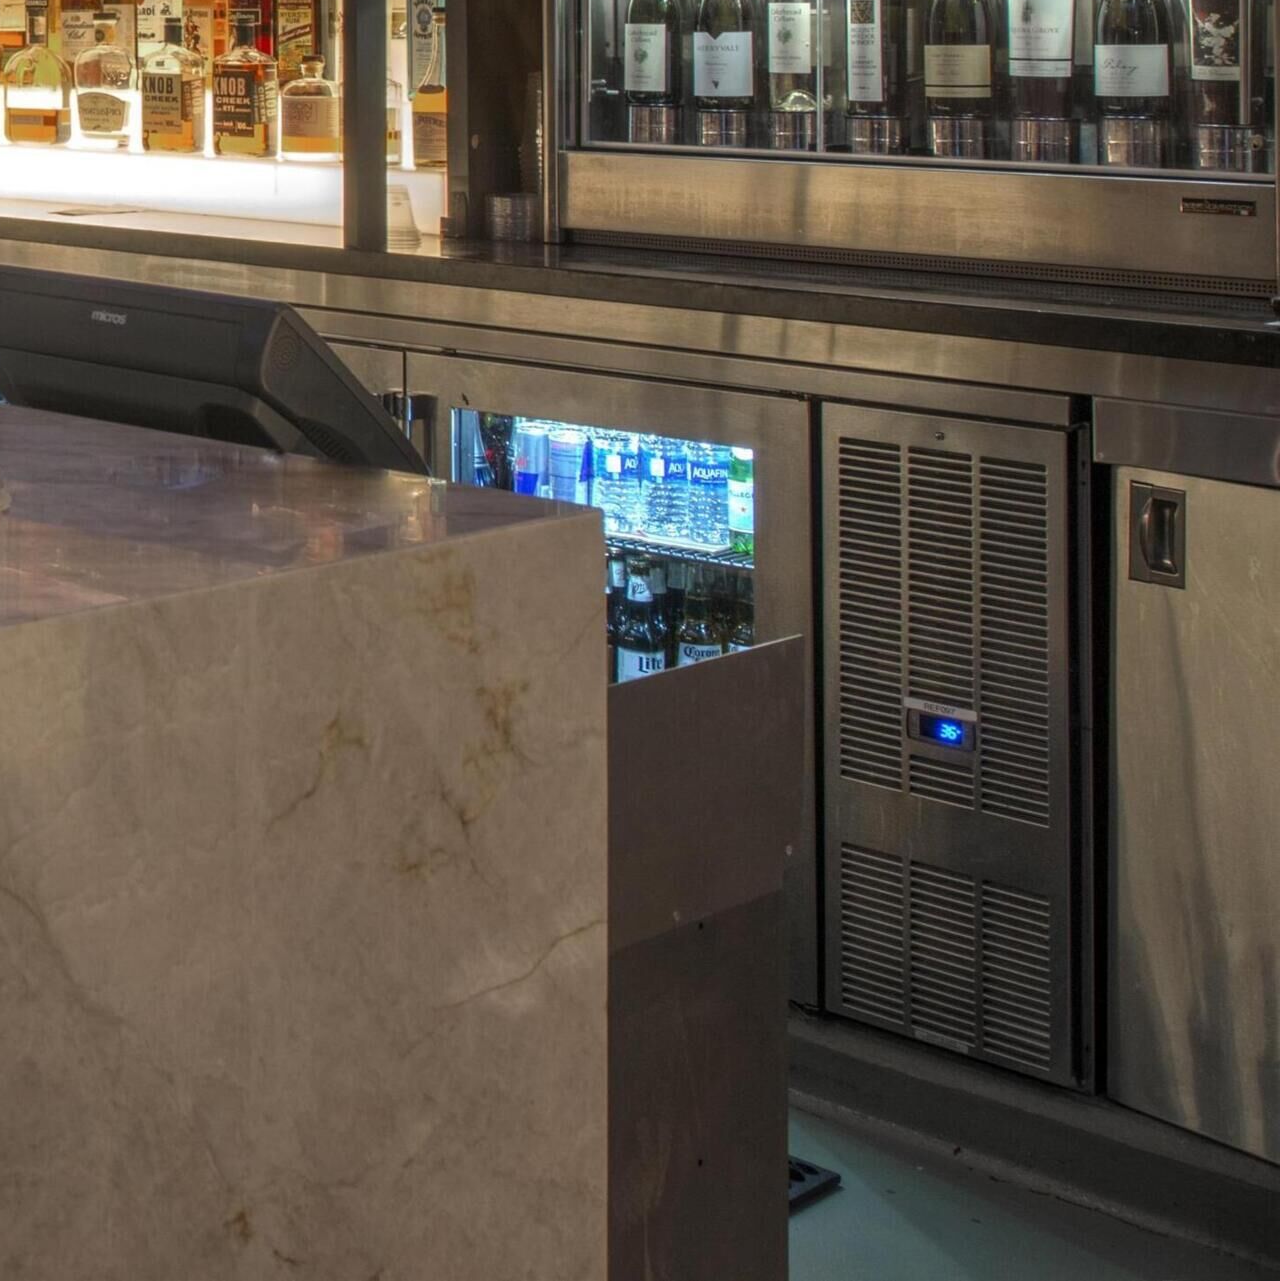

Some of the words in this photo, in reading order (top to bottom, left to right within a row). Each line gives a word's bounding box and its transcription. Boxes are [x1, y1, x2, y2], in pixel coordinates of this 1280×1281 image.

[142, 76, 174, 94] KNOB
[213, 76, 246, 96] KNOB
[144, 95, 180, 103] CREEK
[216, 96, 251, 105] CREEK
[91, 310, 127, 325] micros
[692, 466, 728, 479] AQUAFIN
[683, 645, 721, 659] Coron
[638, 656, 664, 674] Lite
